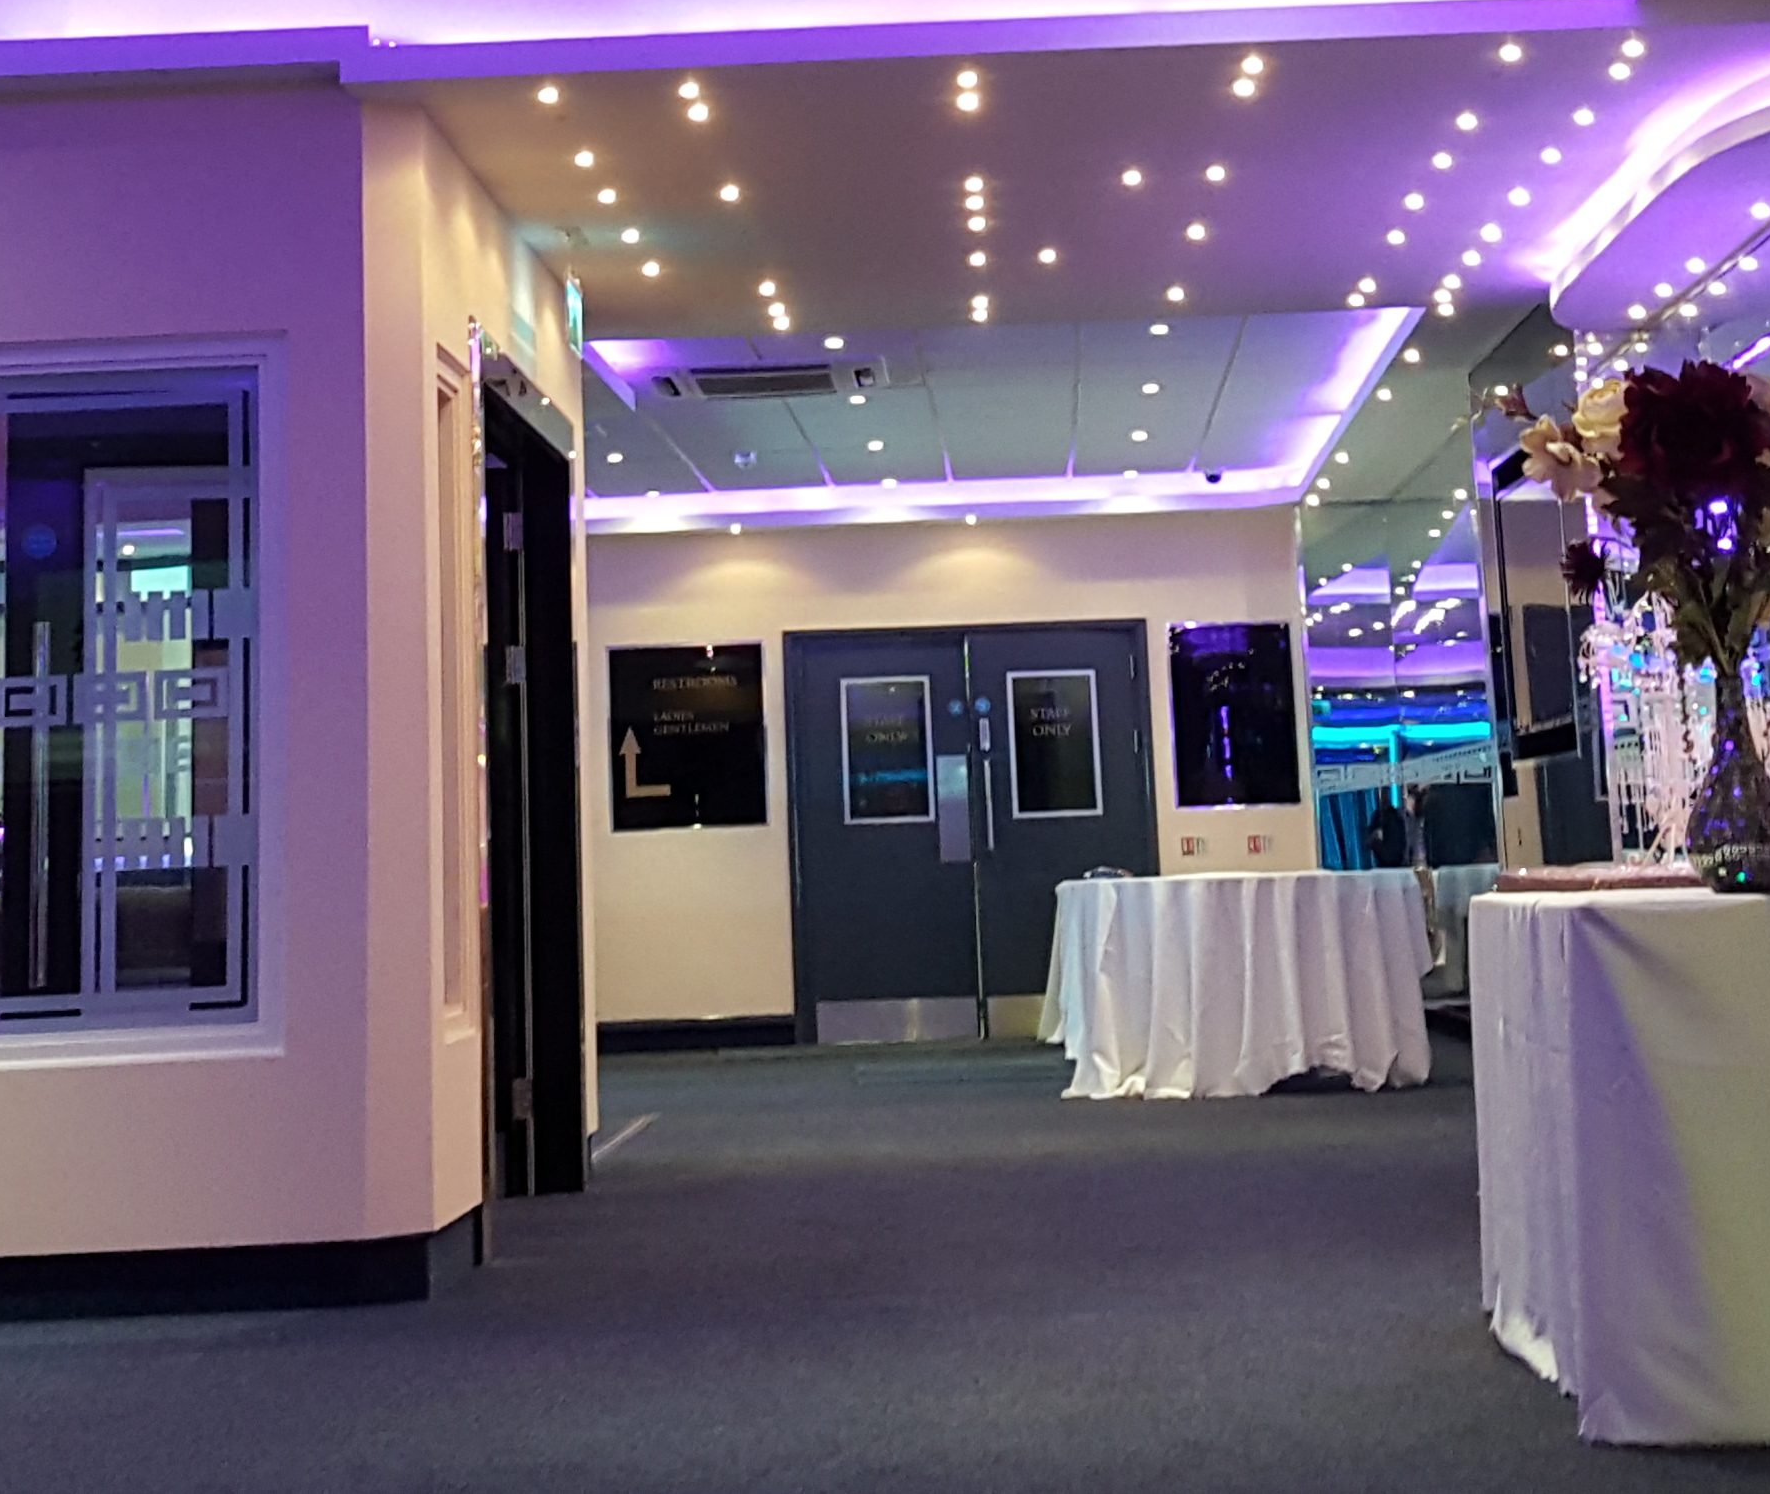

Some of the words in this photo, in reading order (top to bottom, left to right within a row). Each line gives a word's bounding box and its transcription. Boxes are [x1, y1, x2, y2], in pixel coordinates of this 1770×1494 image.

[652, 674, 738, 690] RESTROOMS
[1029, 706, 1071, 720] STAFF
[1032, 723, 1072, 737] ONLY
